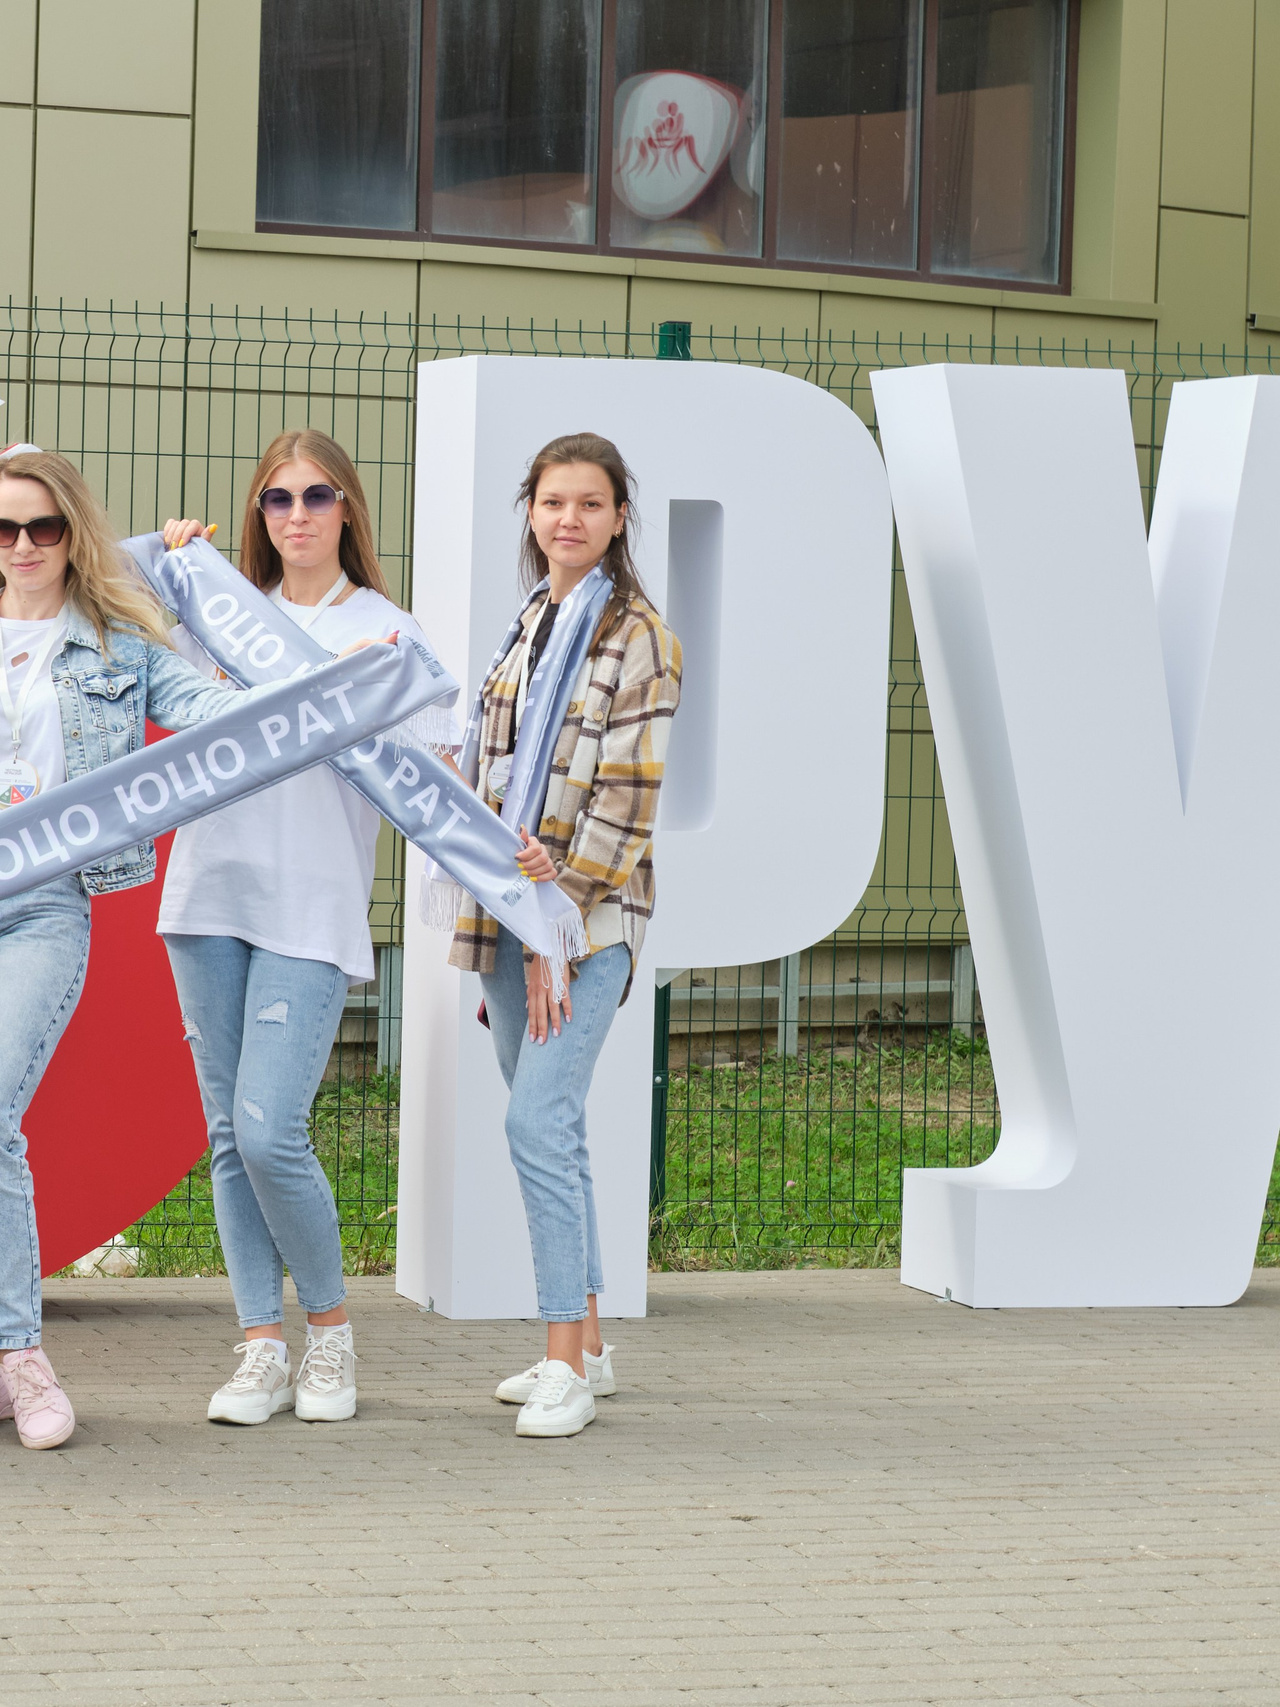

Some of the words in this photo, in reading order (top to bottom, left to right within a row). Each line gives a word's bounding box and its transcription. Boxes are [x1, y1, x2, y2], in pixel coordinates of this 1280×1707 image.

[201, 593, 285, 669] ОЦО
[113, 737, 246, 824] ЮЦО
[257, 680, 357, 759] РАТ
[385, 756, 471, 840] РАТ
